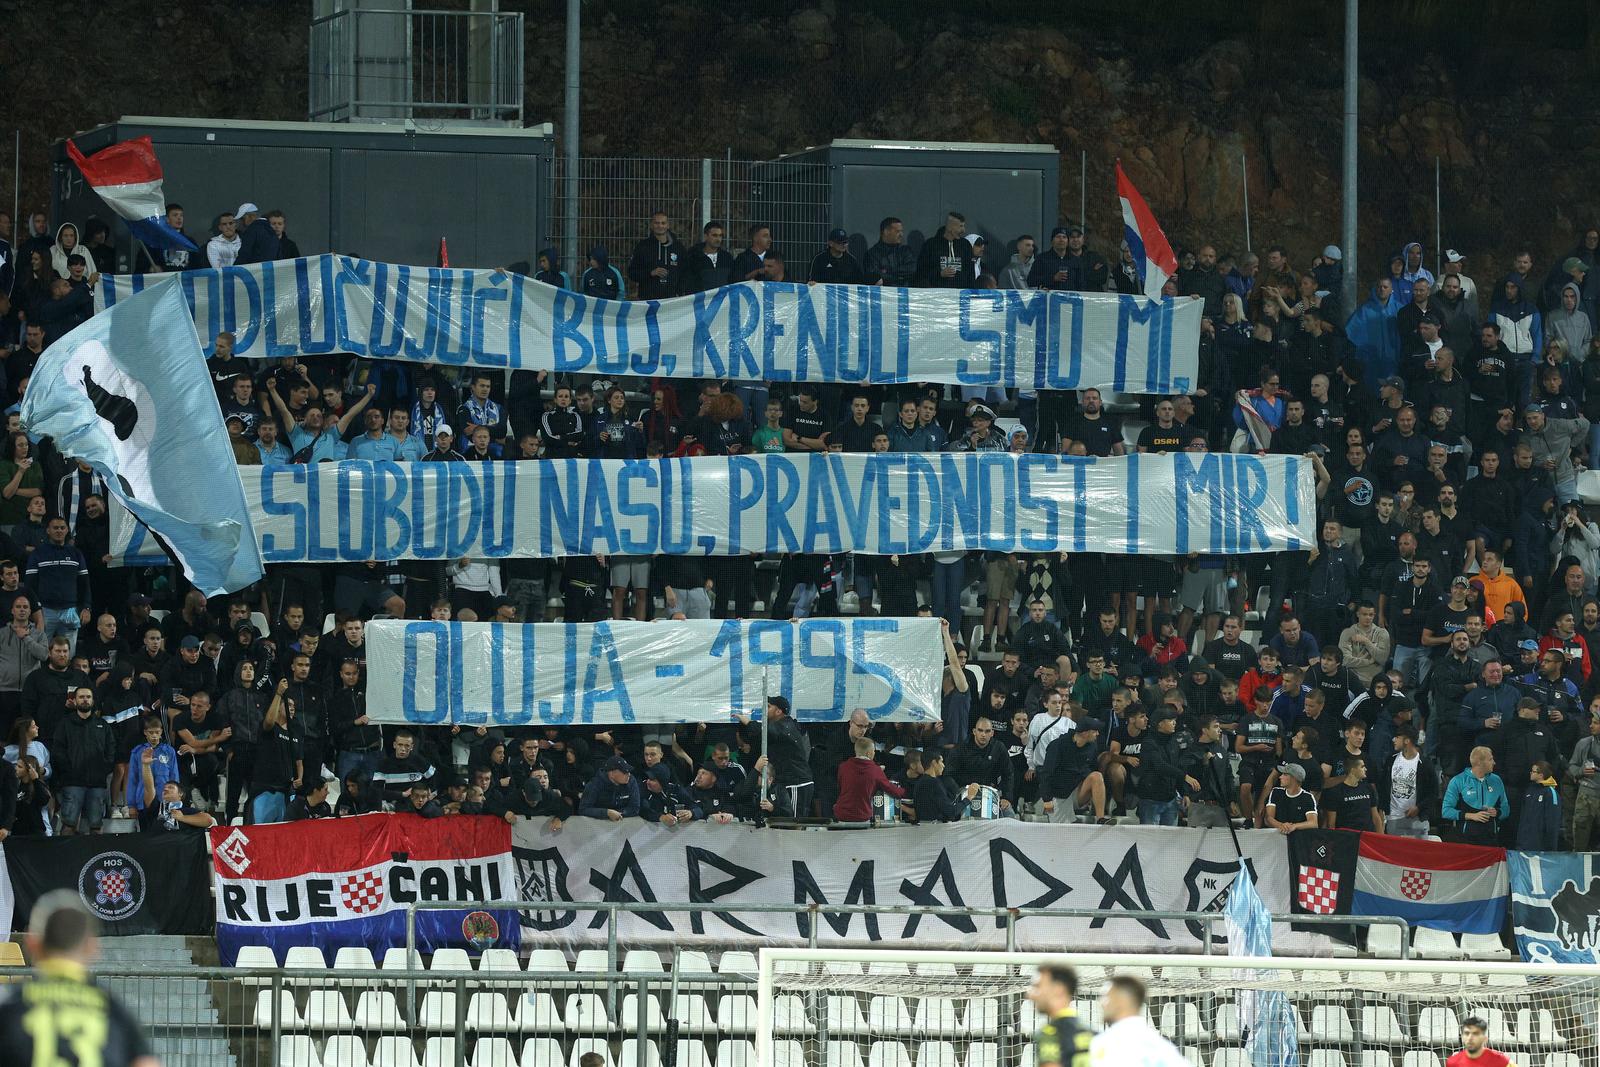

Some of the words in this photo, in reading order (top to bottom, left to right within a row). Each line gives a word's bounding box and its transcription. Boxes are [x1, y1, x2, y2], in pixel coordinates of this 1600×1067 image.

[957, 289, 1084, 389] SMO
[261, 459, 516, 561] SLOBODU
[728, 452, 1096, 555] PRAVEDNOST
[1127, 453, 1139, 552] I
[403, 621, 634, 725] OLUJA
[655, 664, 684, 677] -
[103, 859, 122, 867] HOS
[587, 838, 1171, 941] ARMADA
[1203, 878, 1217, 890] NK
